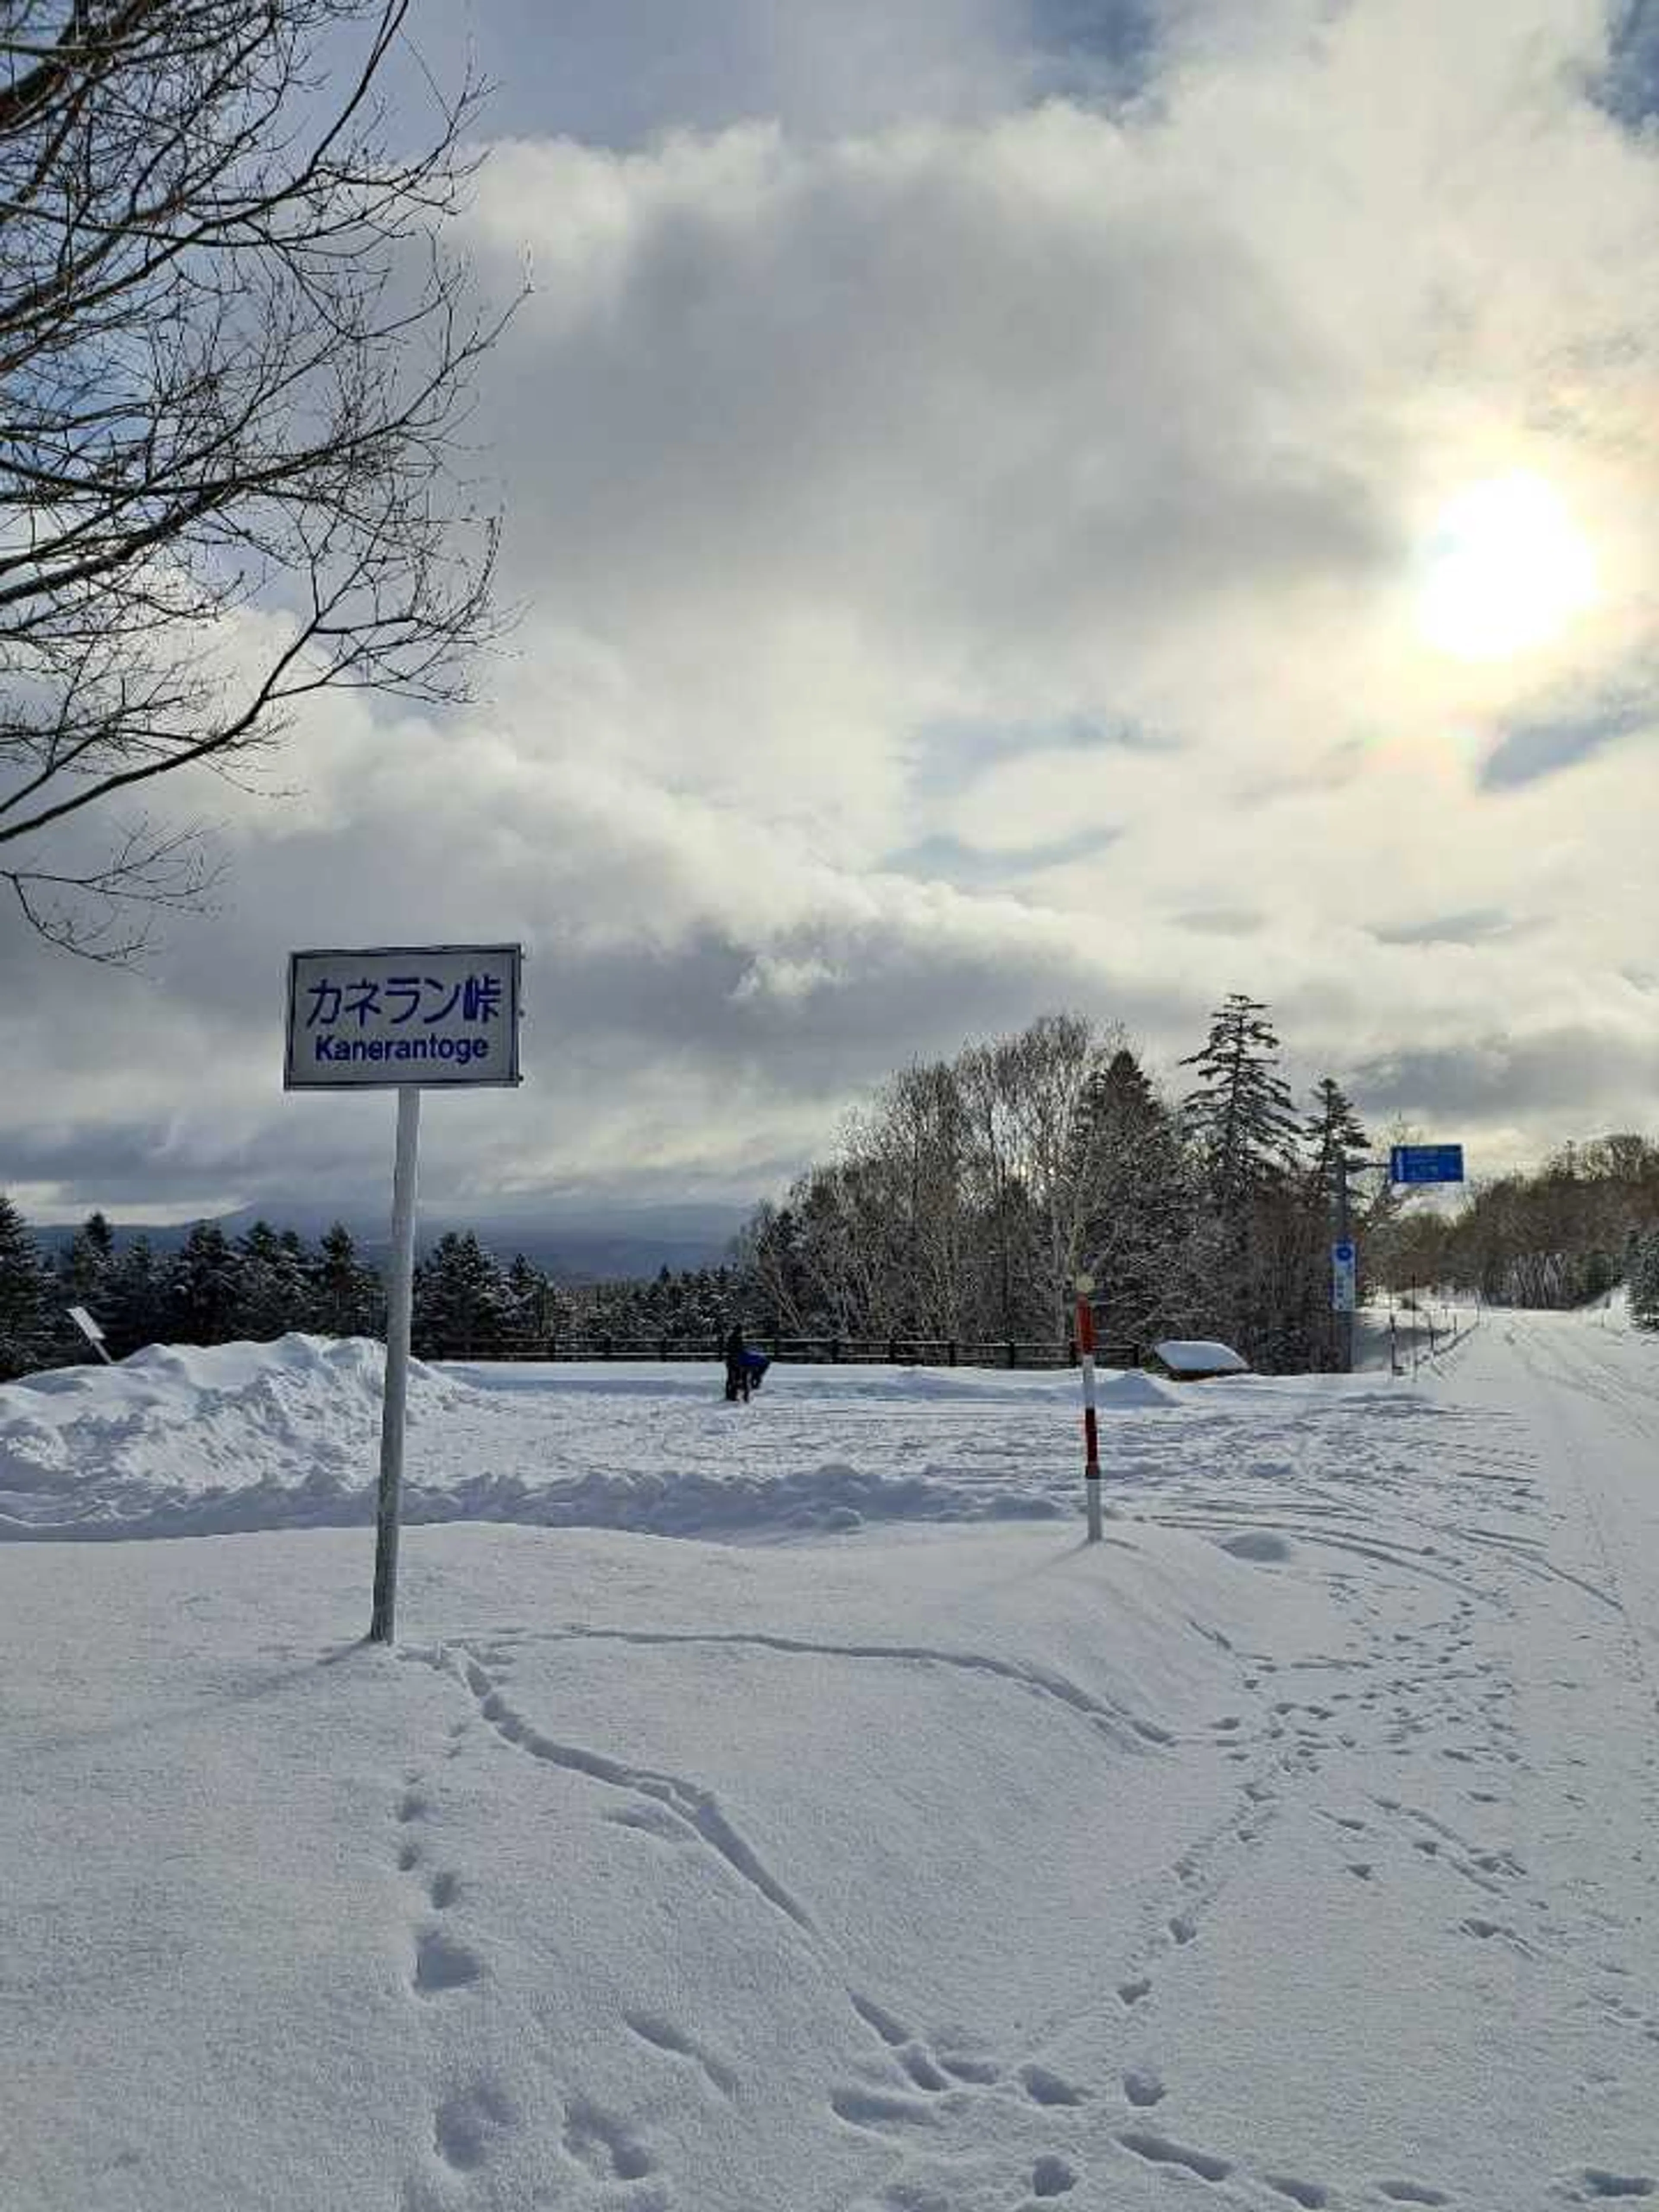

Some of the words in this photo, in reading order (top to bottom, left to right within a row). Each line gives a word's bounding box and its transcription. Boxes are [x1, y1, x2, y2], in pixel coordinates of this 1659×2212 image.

[306, 974, 501, 1027] カネラン峠
[315, 1033, 489, 1065] Kanerantoge
